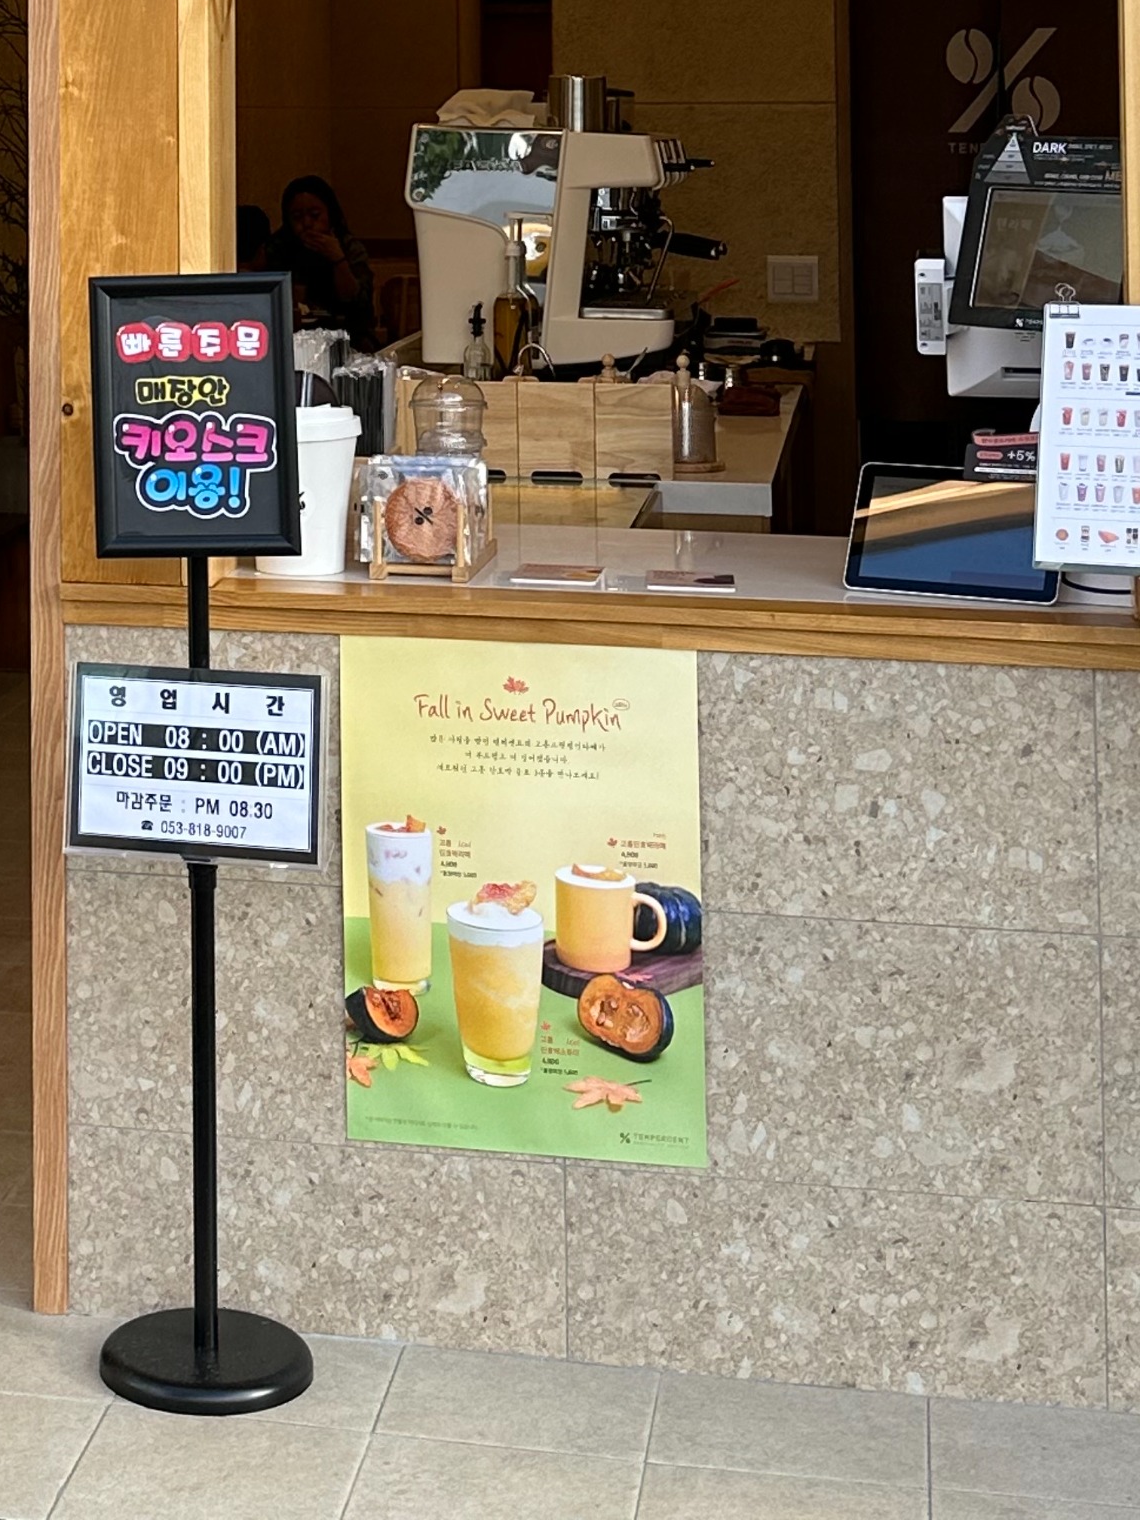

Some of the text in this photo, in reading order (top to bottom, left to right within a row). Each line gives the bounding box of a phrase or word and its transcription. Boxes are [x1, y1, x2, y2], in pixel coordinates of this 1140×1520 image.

[947, 141, 984, 155] TEN
[1032, 141, 1068, 155] DARK
[119, 324, 261, 358] 빠른주문
[137, 377, 228, 407] 매장안
[121, 420, 269, 462] 키오스크
[1007, 450, 1036, 463] +5%
[145, 464, 241, 510] 이용!
[414, 694, 622, 732] Fall in Sweet Pumpkin
[88, 720, 143, 745] OPEN
[165, 726, 190, 749] 08
[218, 730, 244, 752] 00
[256, 731, 305, 757] (AM)
[87, 751, 153, 777] CLOSE
[164, 757, 189, 780] 09
[217, 761, 243, 784] 00
[255, 763, 304, 788] (PM)
[116, 791, 173, 813] 마감주문
[195, 798, 220, 816] PM
[229, 800, 273, 819] 08:30
[160, 820, 247, 840] 053-818-9007
